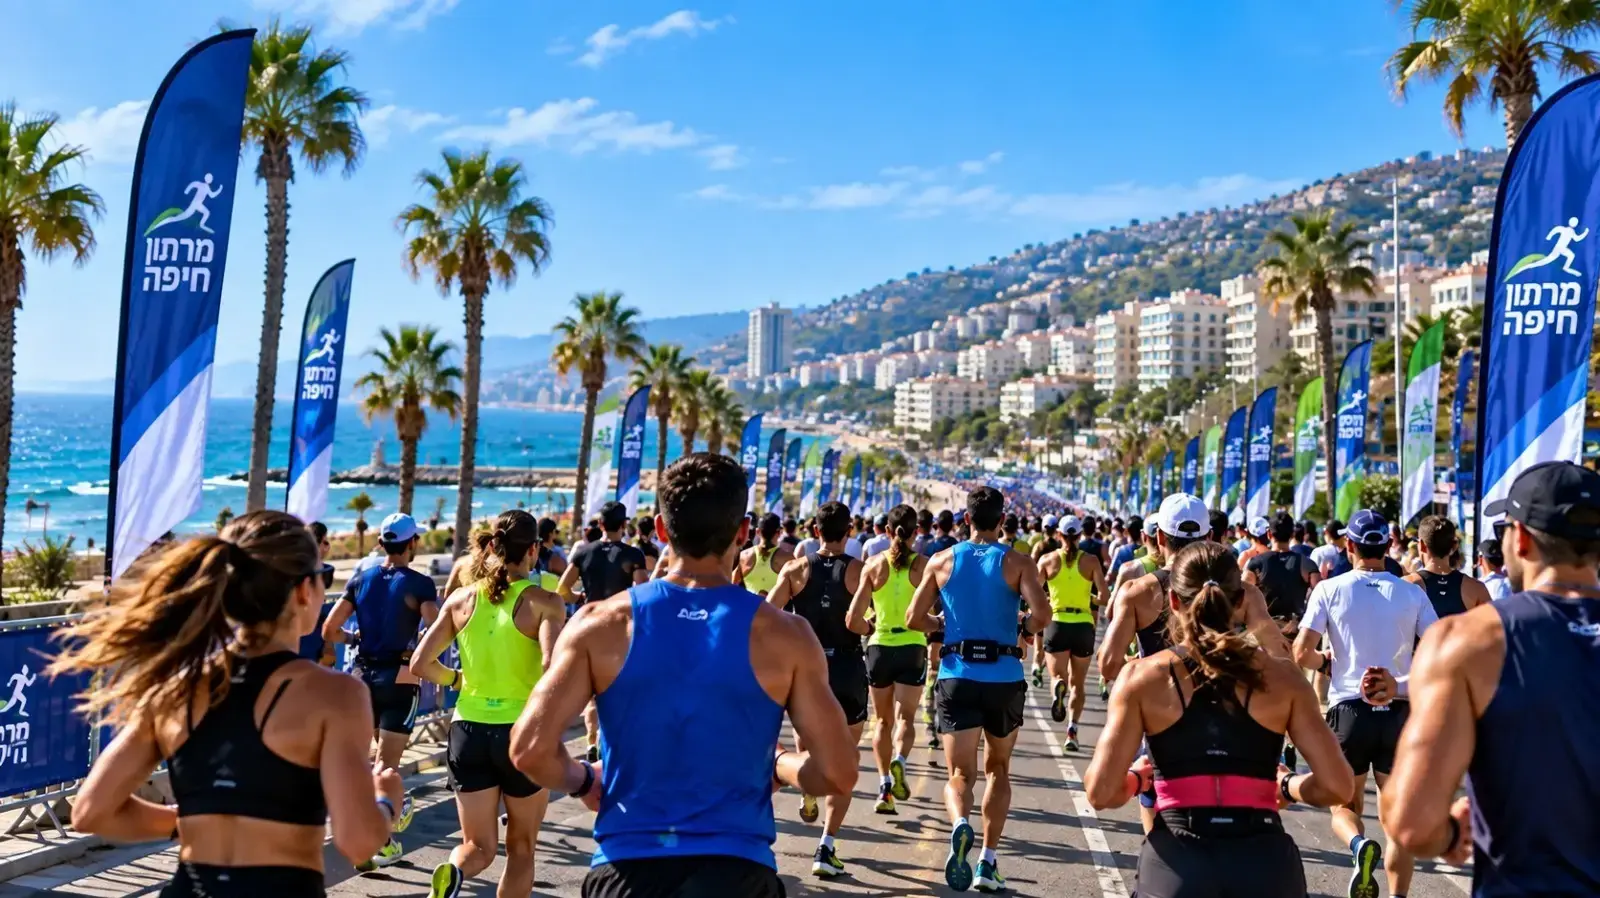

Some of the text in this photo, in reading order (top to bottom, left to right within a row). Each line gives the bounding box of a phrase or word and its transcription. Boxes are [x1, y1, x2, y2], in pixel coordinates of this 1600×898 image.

[145, 237, 214, 265] מרתון
[142, 266, 211, 292] חיפה
[1505, 282, 1581, 311] מרתון
[1503, 310, 1578, 335] חיפה
[302, 384, 334, 400] חיפה
